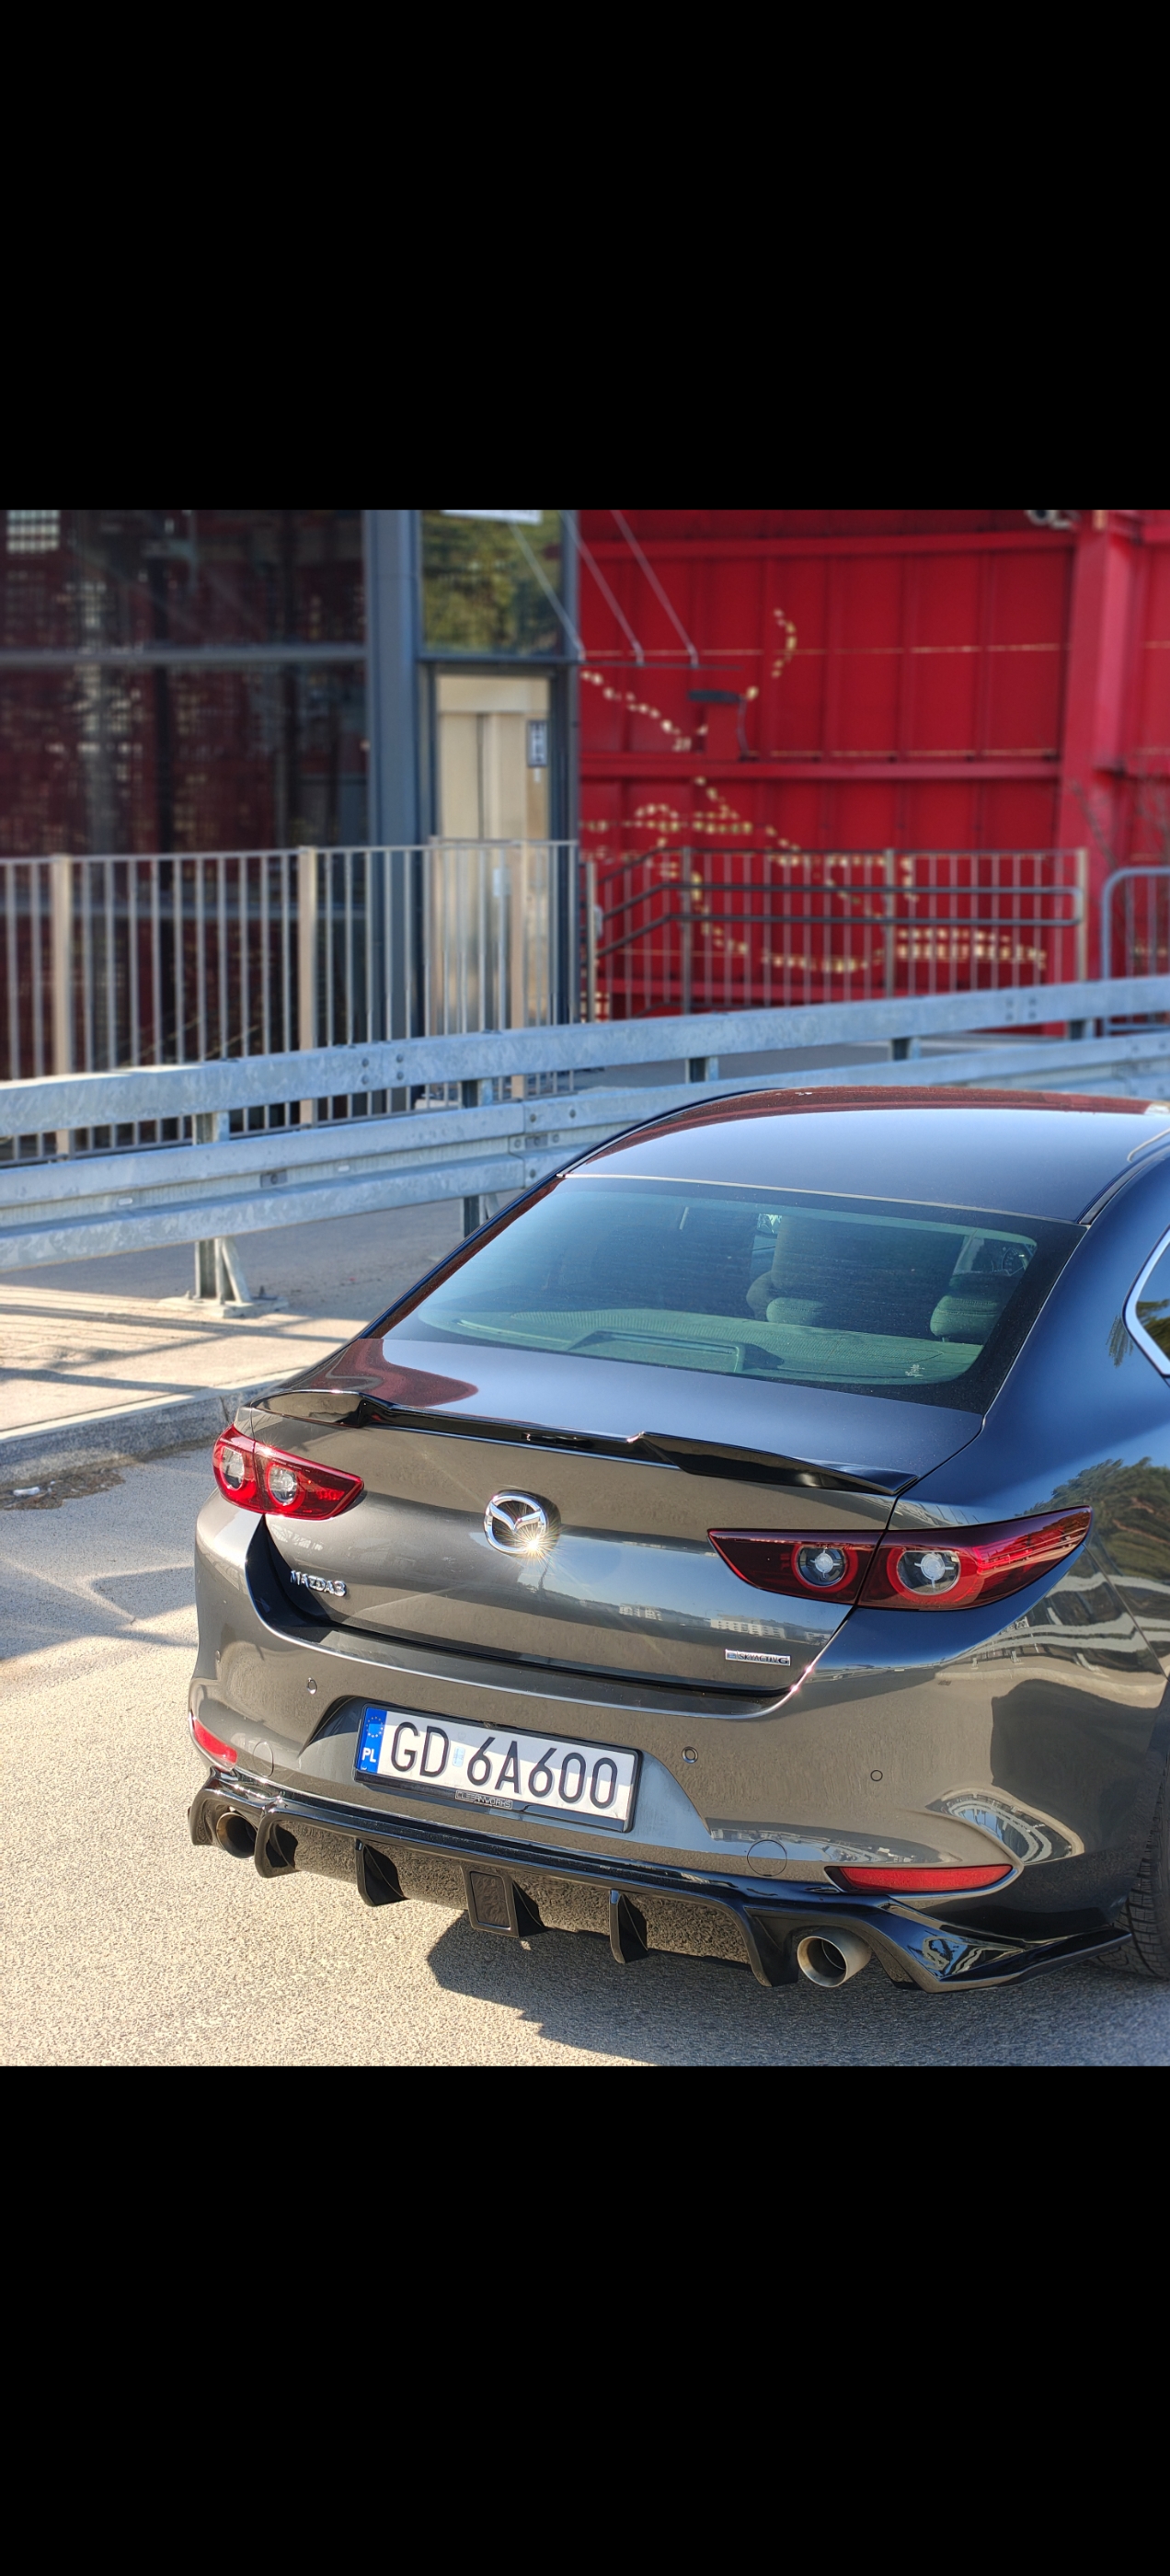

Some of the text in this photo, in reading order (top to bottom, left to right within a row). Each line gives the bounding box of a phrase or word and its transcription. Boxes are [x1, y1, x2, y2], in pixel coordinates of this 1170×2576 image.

[290, 1570, 347, 1596] MAZDA3
[361, 1747, 377, 1764] PL
[391, 1721, 618, 1810] GD 6A600
